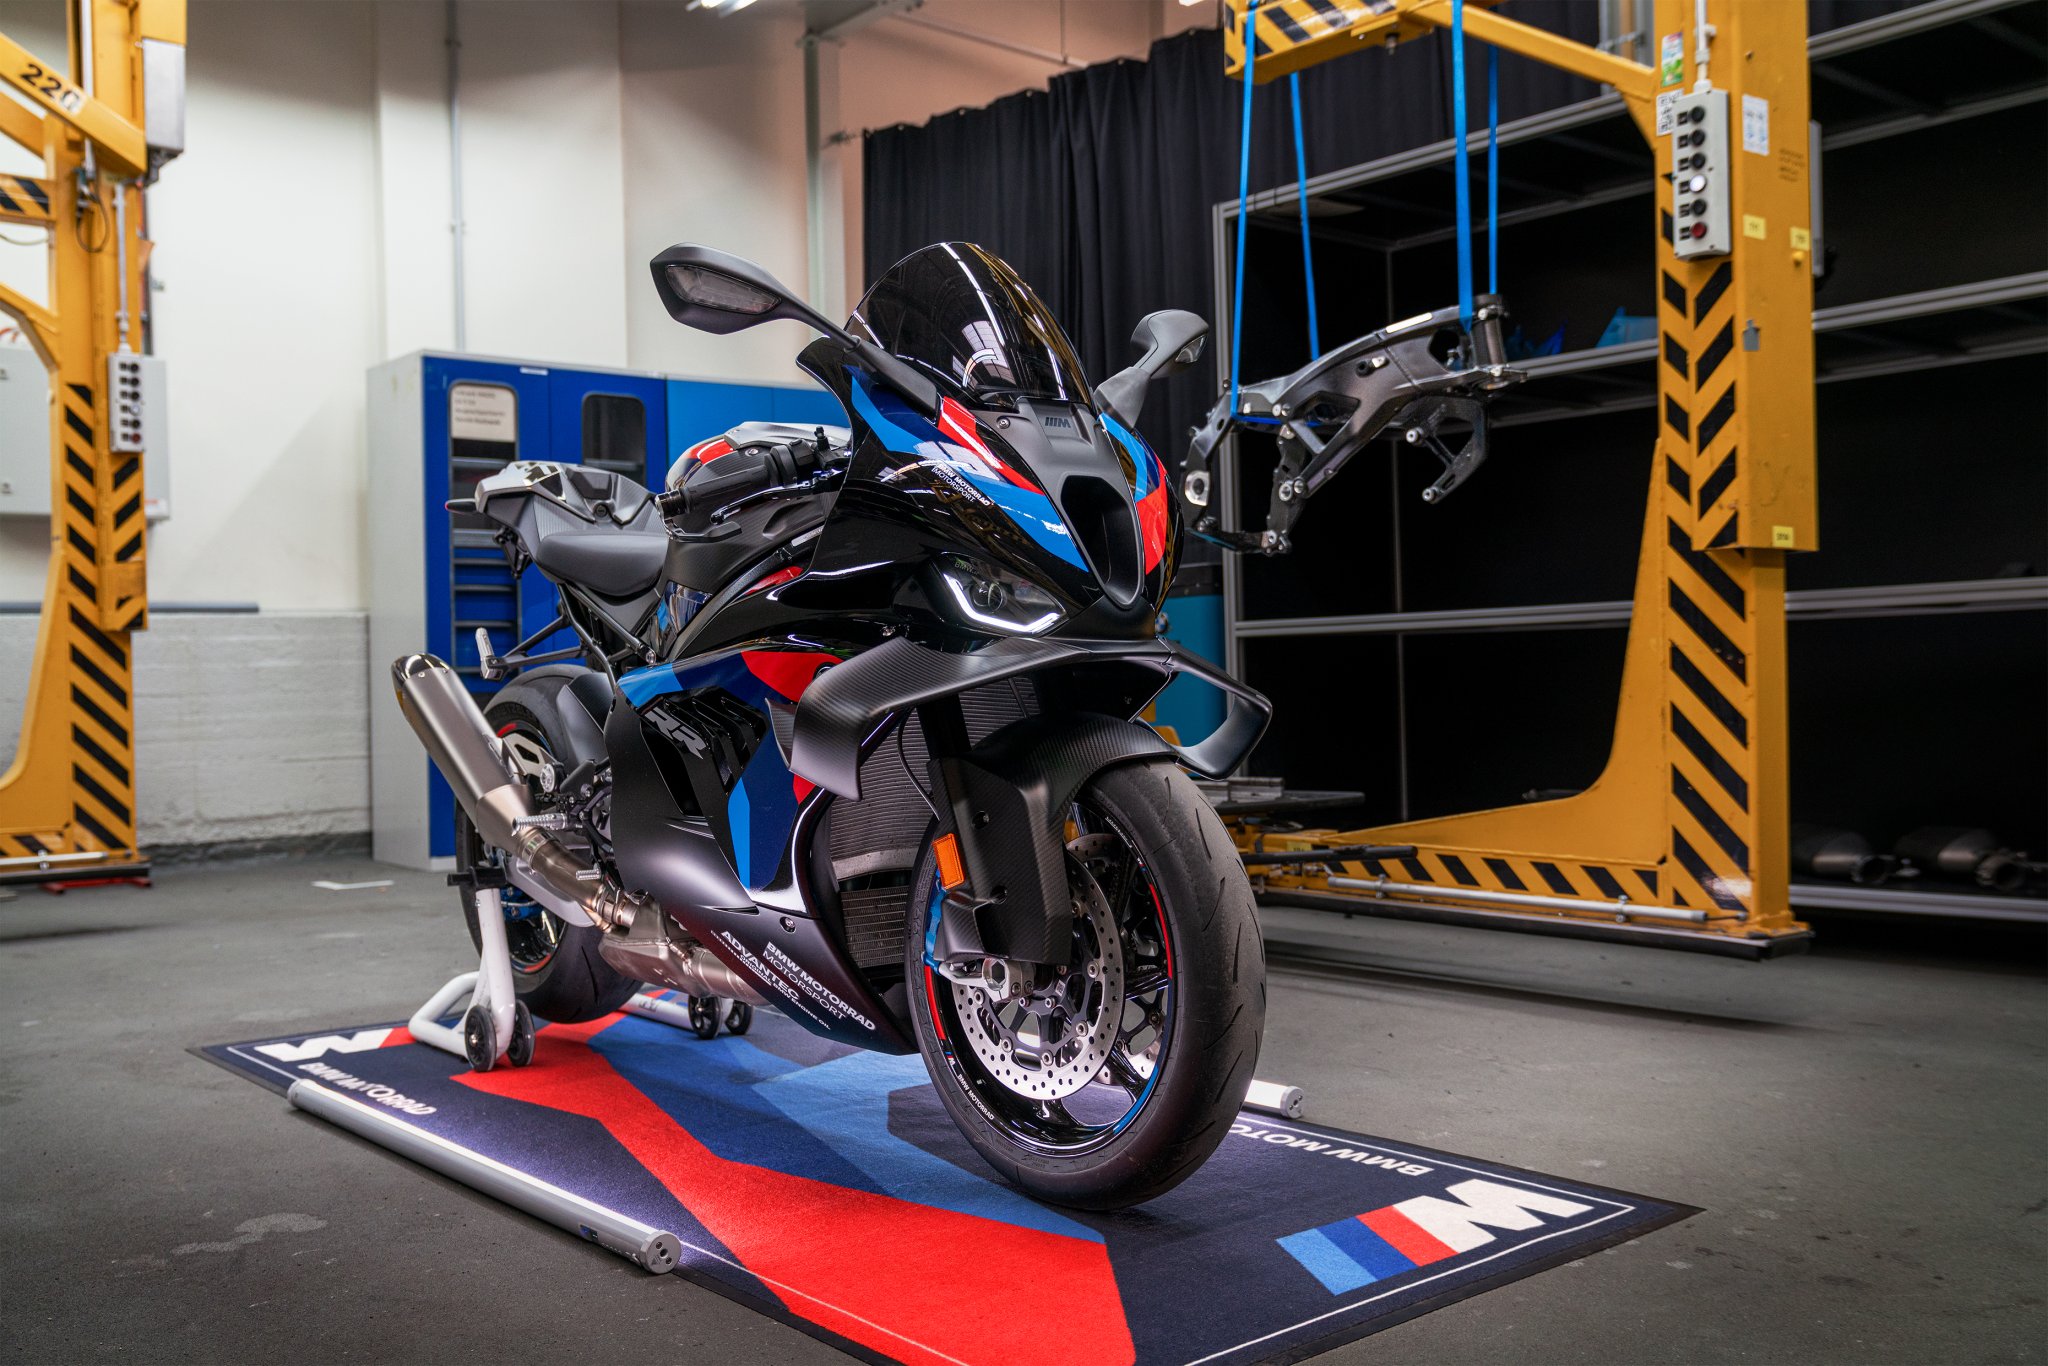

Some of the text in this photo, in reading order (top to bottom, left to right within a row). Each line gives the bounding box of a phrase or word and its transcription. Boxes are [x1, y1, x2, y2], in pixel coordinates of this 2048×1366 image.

[931, 467, 975, 503] MOTORSPORT
[937, 463, 991, 506] BMW MOTORRAD
[644, 706, 706, 759] RR
[721, 930, 800, 1000] ADVANTEC
[762, 950, 847, 1020] MOTORSPORT
[765, 941, 876, 1031] BMW MOTORRAD
[740, 954, 831, 1031] ORIGINAL BMW ENGINE OIL
[958, 1074, 995, 1120] BMW MOTORRAD
[1322, 1148, 1434, 1177] BMW
